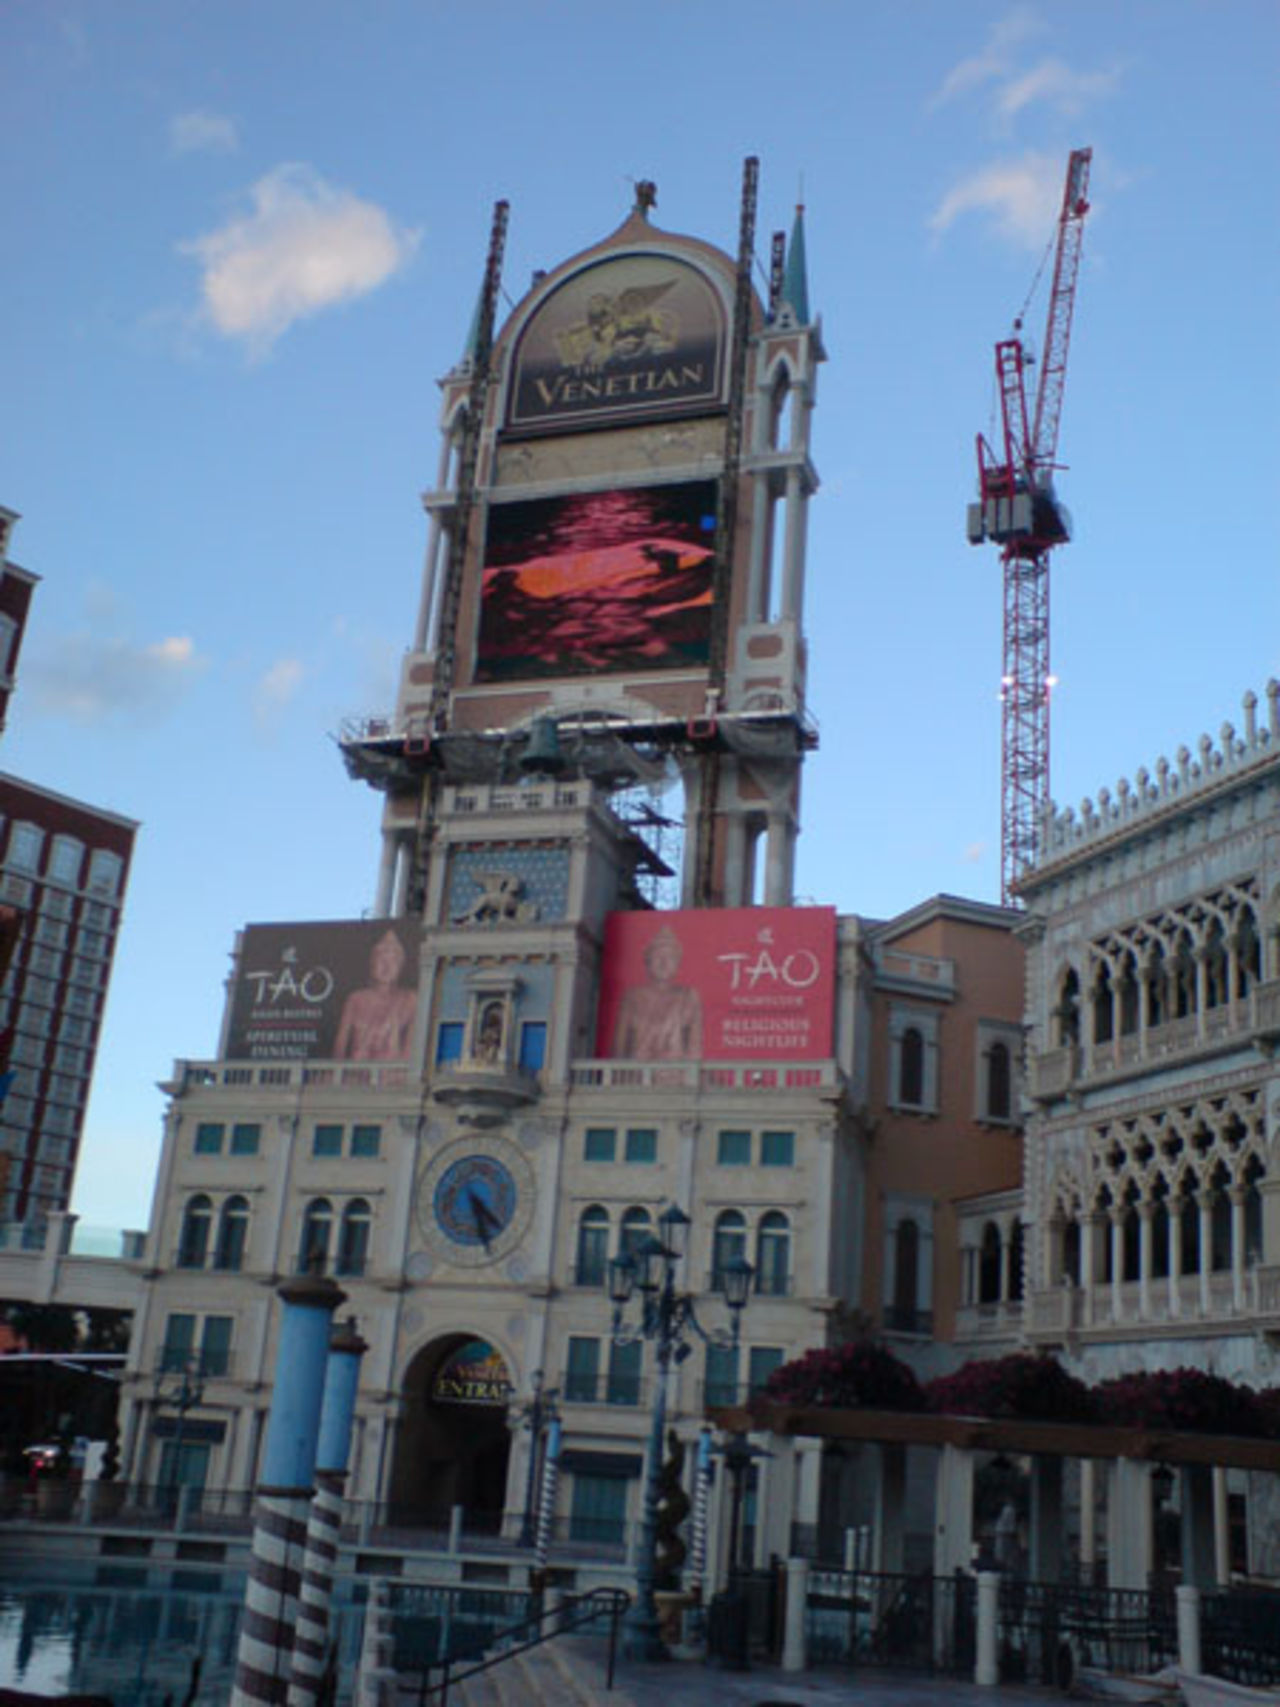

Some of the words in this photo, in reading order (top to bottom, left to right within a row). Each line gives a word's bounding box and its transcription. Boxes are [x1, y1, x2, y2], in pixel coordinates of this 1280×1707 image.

[536, 363, 704, 405] VENETIAN
[245, 966, 334, 1003] TAO
[716, 949, 820, 990] TAO
[723, 1017, 810, 1032] RELIGIOUS
